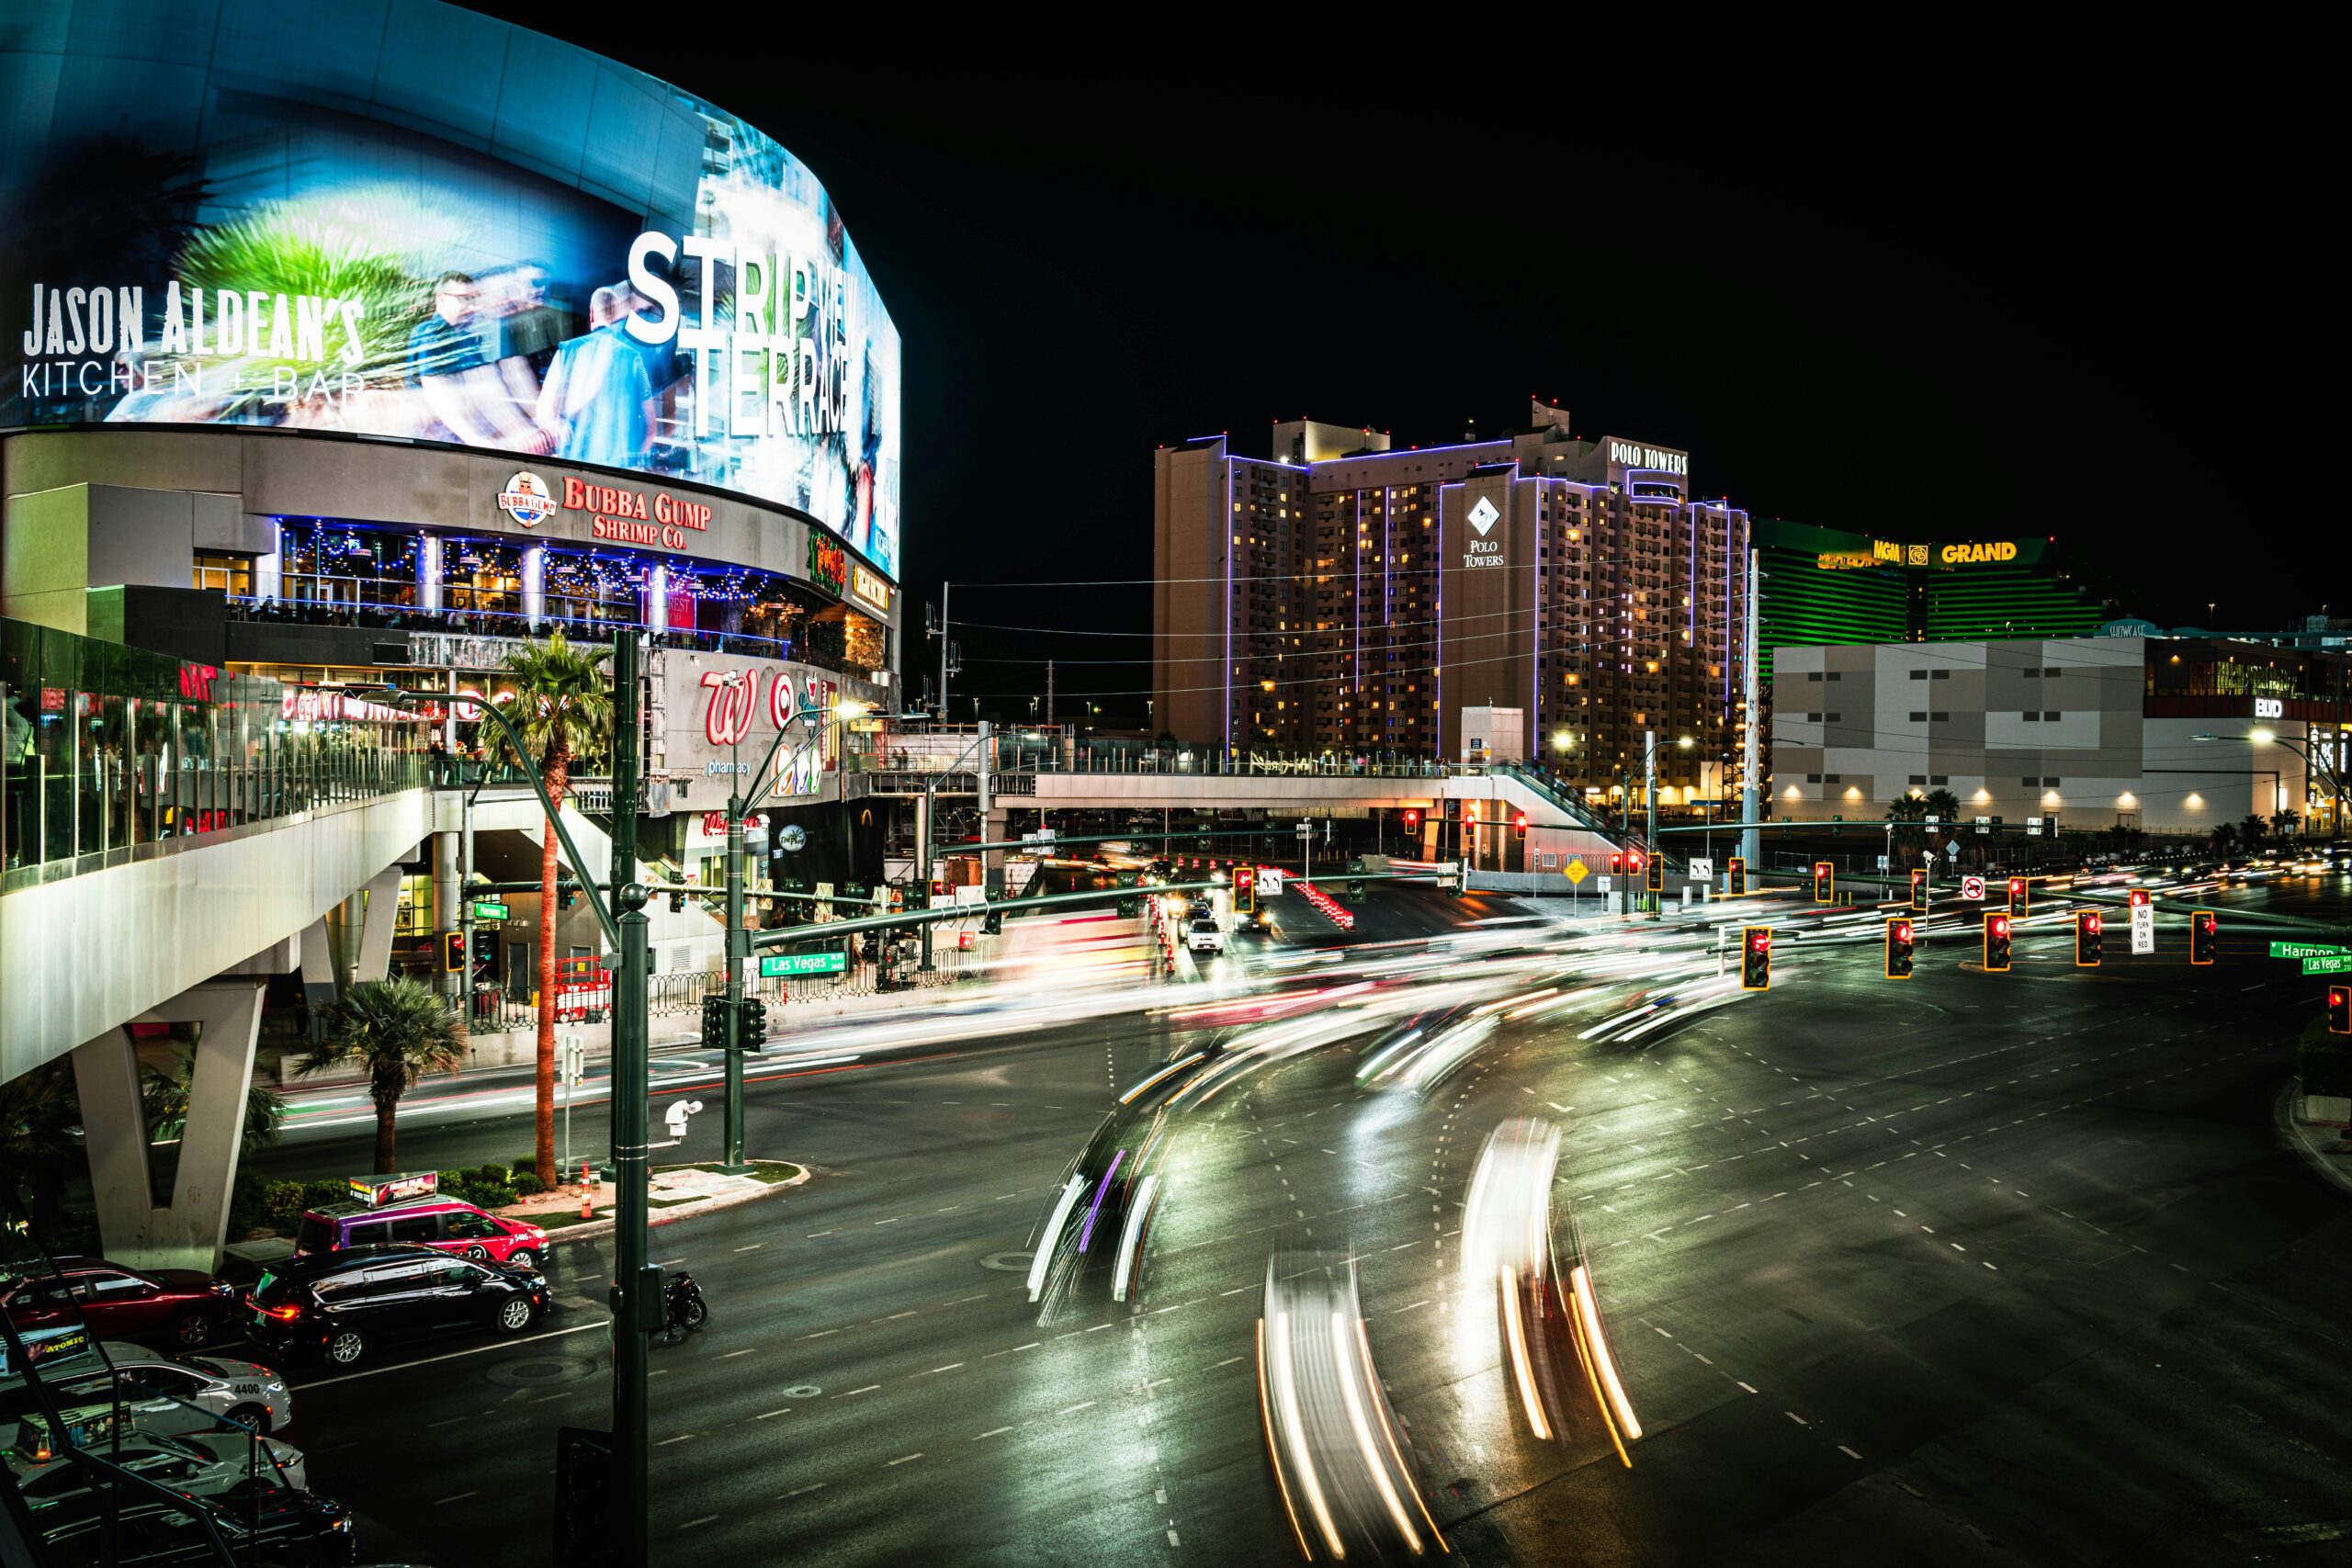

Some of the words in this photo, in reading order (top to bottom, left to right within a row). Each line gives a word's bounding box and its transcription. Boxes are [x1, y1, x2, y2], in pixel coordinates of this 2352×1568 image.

[625, 231, 812, 345] STRIP
[23, 283, 144, 356] JASON
[160, 280, 365, 366] ALDEAN'S
[23, 361, 201, 399] KITCHEN
[275, 367, 366, 406] BAR
[677, 328, 851, 439] TERRACE
[1611, 442, 1641, 466] POLO
[1645, 448, 1688, 476] TOWERS
[500, 494, 529, 507] BUBBA
[531, 498, 556, 513] GUMP
[562, 476, 649, 521] BUBBA
[654, 492, 712, 531] GUMP
[593, 514, 659, 546] SHRIMP
[662, 525, 687, 550] CO.
[1470, 540, 1498, 553] POLO
[1873, 540, 1900, 562] MGM
[1940, 542, 2018, 563] GRAND
[1463, 554, 1504, 568] TOWERS
[2109, 625, 2146, 637] SHOWCASE
[2138, 909, 2148, 919] NO
[2136, 921, 2150, 930] TURN
[2138, 941, 2148, 949] RED
[2282, 944, 2335, 957] Harmon
[772, 958, 791, 972] Las
[793, 955, 827, 973] Vegas
[2308, 958, 2321, 971] Las
[2321, 957, 2342, 973] Vegas
[46, 1336, 85, 1354] ATOMIC
[234, 1383, 260, 1394] 4400
